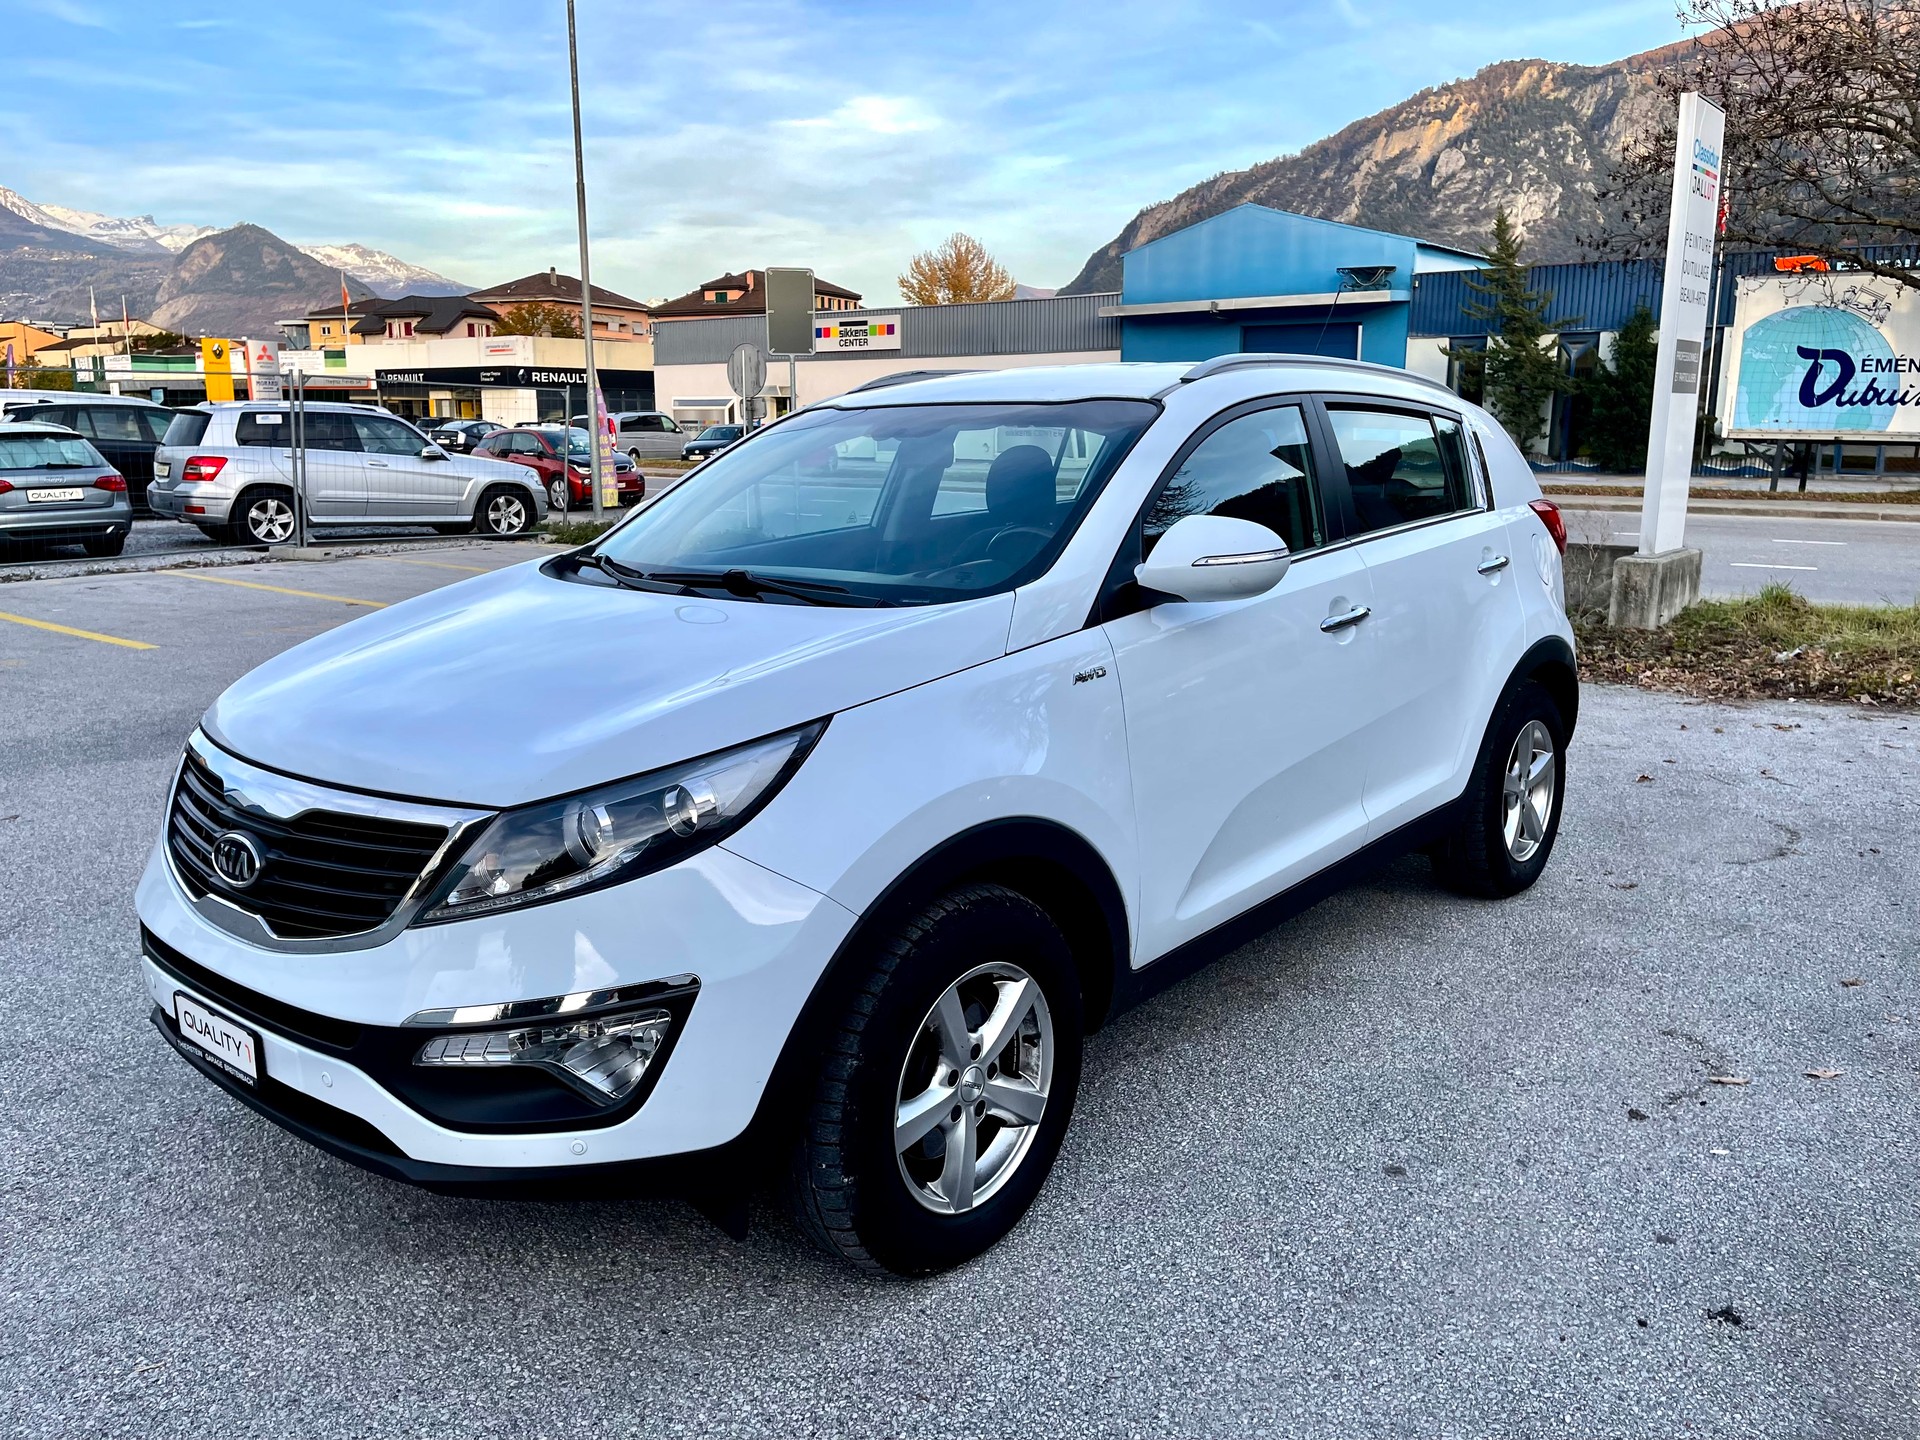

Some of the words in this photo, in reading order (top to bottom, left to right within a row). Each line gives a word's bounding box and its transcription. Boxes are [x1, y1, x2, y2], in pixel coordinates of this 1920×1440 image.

[1692, 175, 1715, 202] JALLUT
[1685, 231, 1711, 254] PEINTURE
[1683, 259, 1709, 280] OUTILLAGE
[838, 338, 868, 347] CENTER
[839, 328, 868, 338] sikkens
[531, 371, 588, 384] RENAULT
[1072, 665, 1107, 686] AWD
[218, 842, 249, 879] KIA
